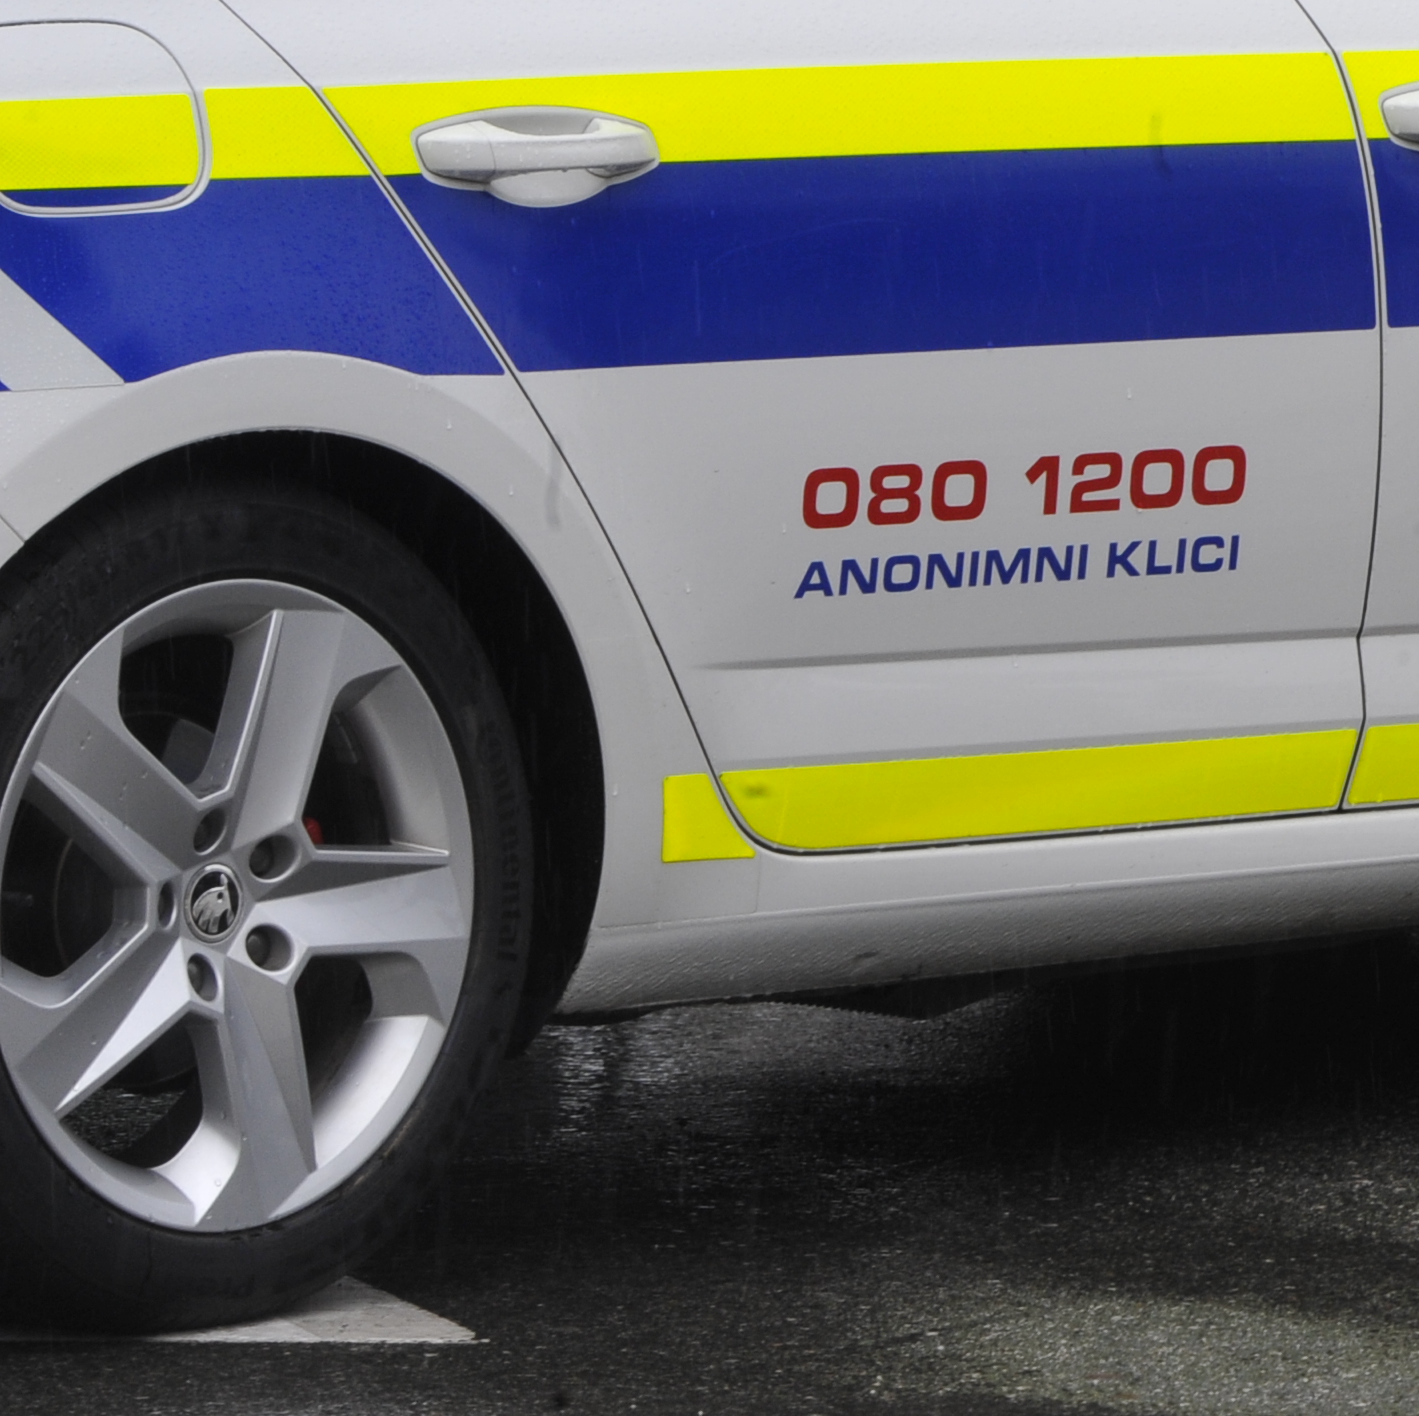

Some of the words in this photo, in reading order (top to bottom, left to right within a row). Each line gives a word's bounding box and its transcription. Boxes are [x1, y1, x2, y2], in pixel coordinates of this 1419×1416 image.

[801, 459, 988, 529] 080
[1024, 444, 1247, 515] 1200
[793, 543, 1090, 599] ANONIMNI
[1105, 534, 1241, 579] KLICI
